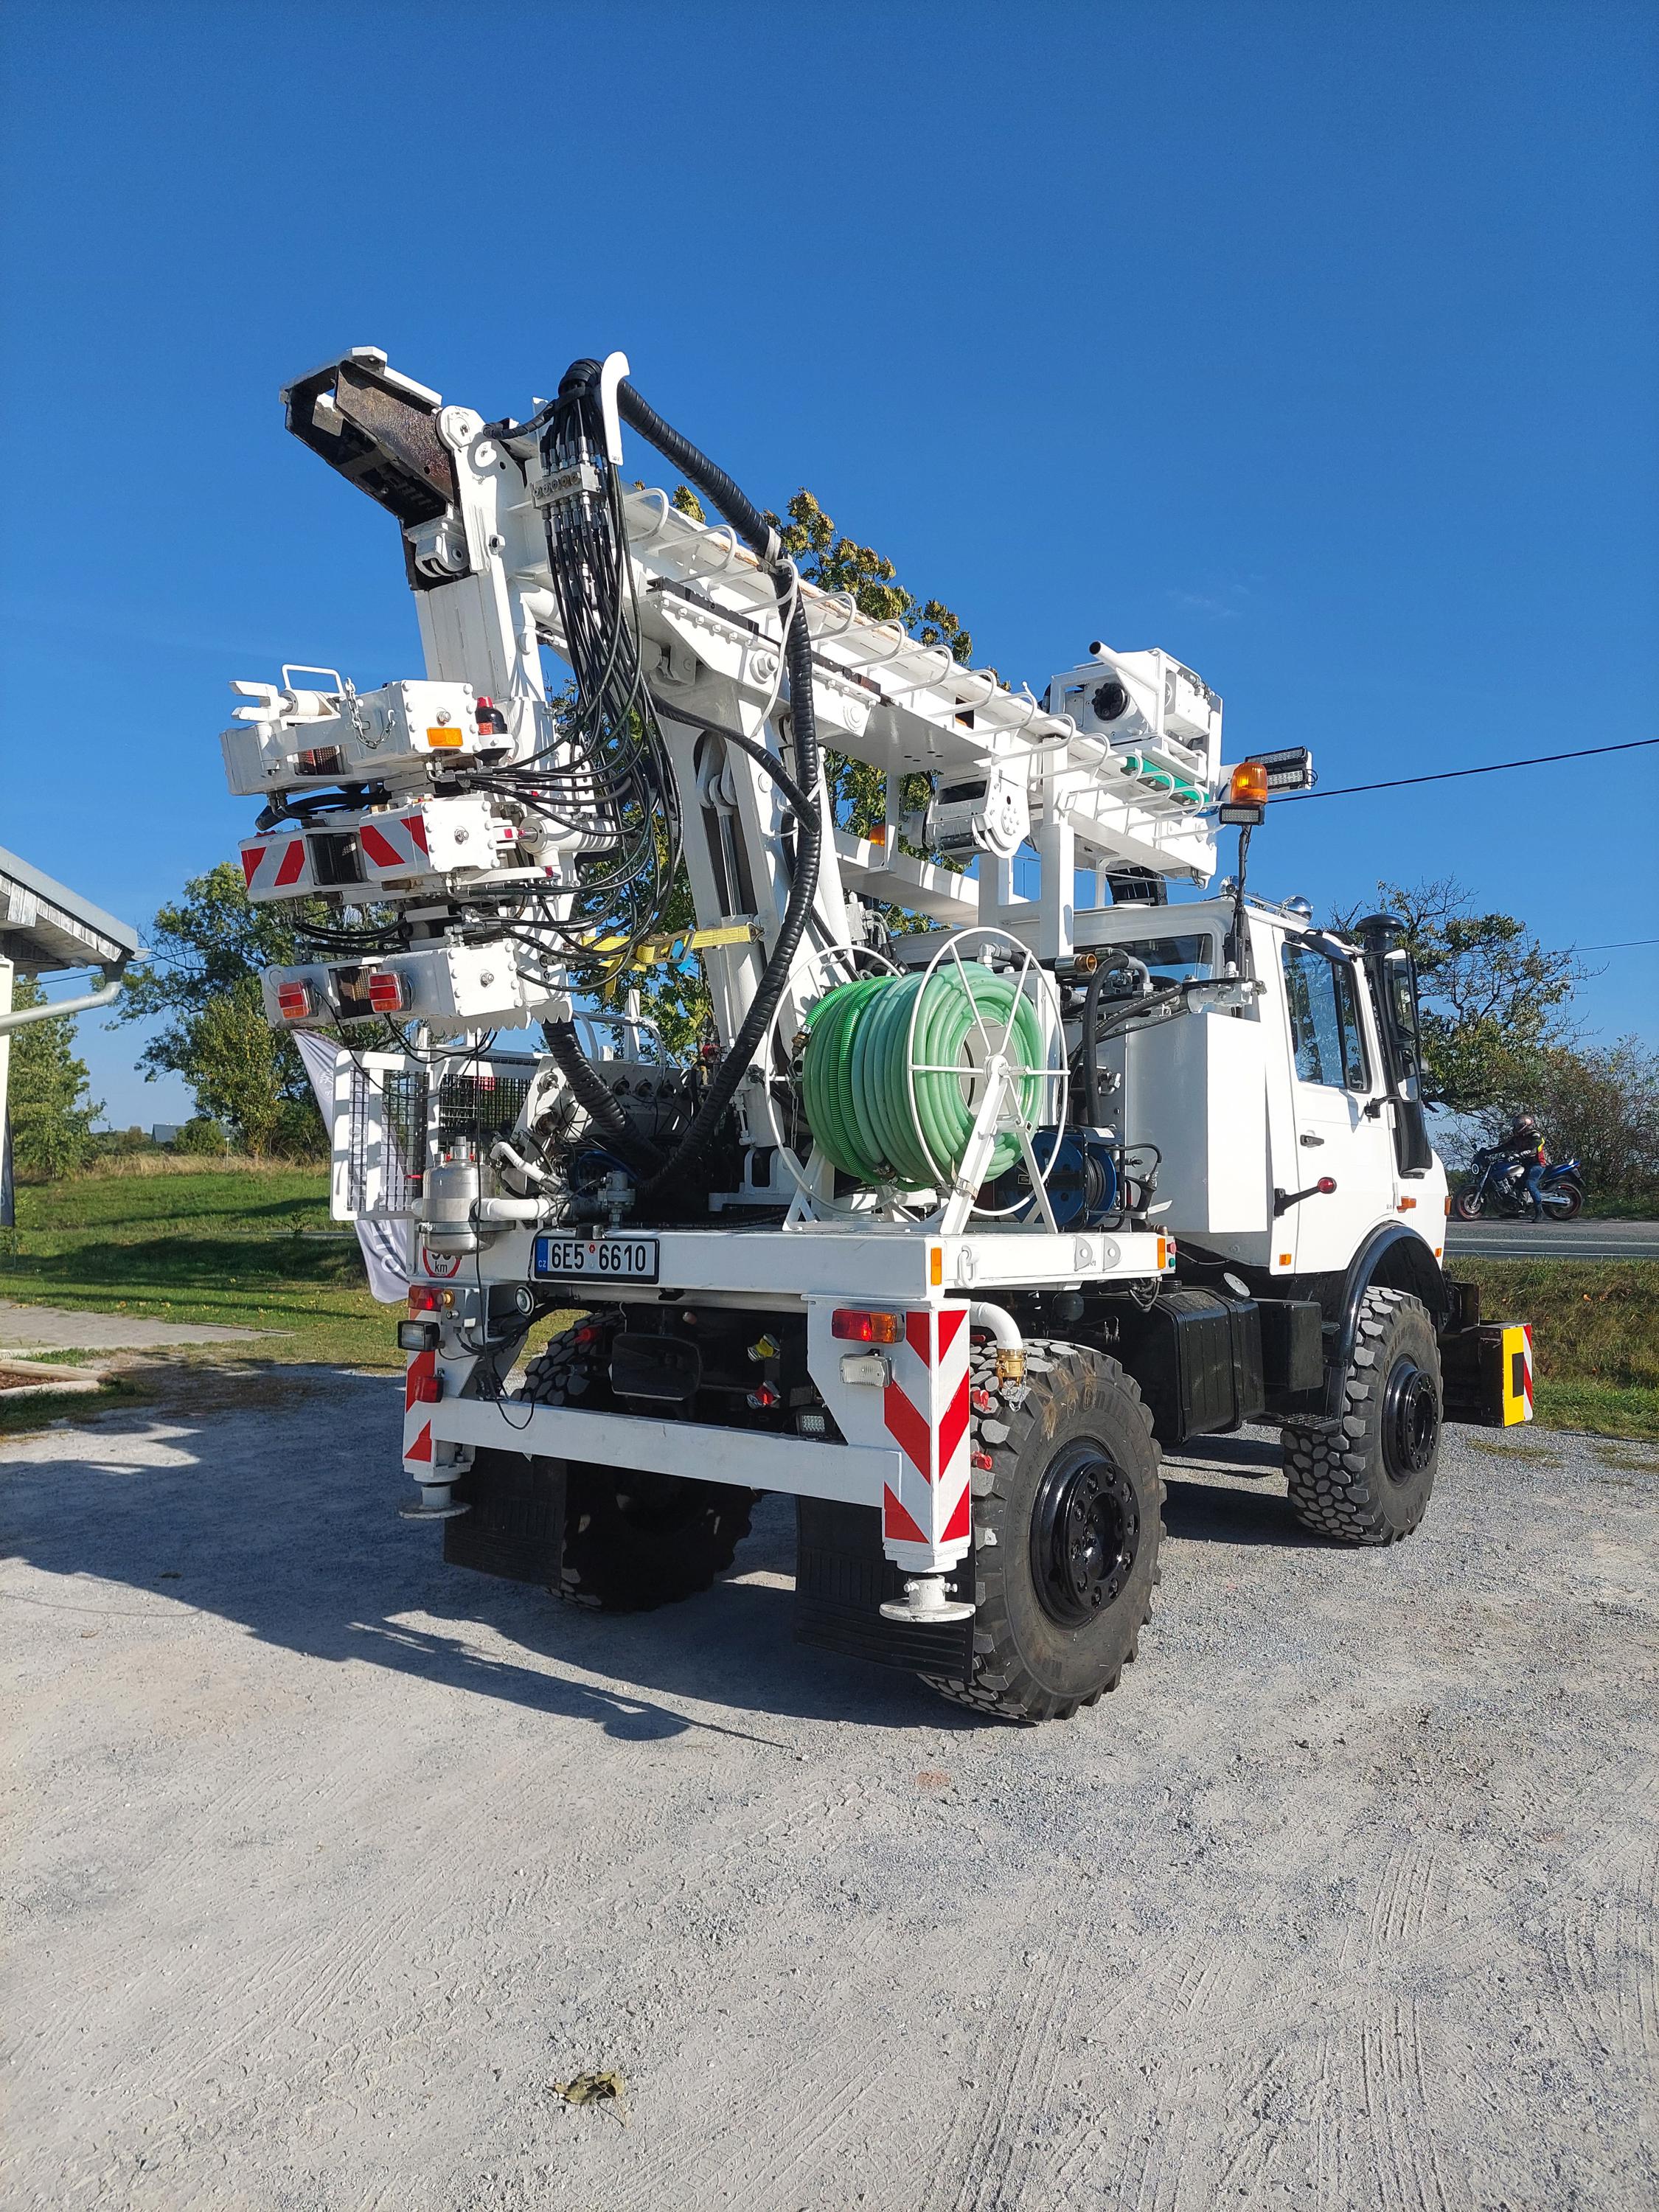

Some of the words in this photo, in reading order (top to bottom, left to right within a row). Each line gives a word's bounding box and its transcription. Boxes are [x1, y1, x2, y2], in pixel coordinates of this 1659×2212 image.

[538, 1259, 546, 1268] CZ
[552, 1243, 585, 1270] 6E5
[599, 1244, 646, 1272] 6610
[434, 1260, 448, 1273] km
